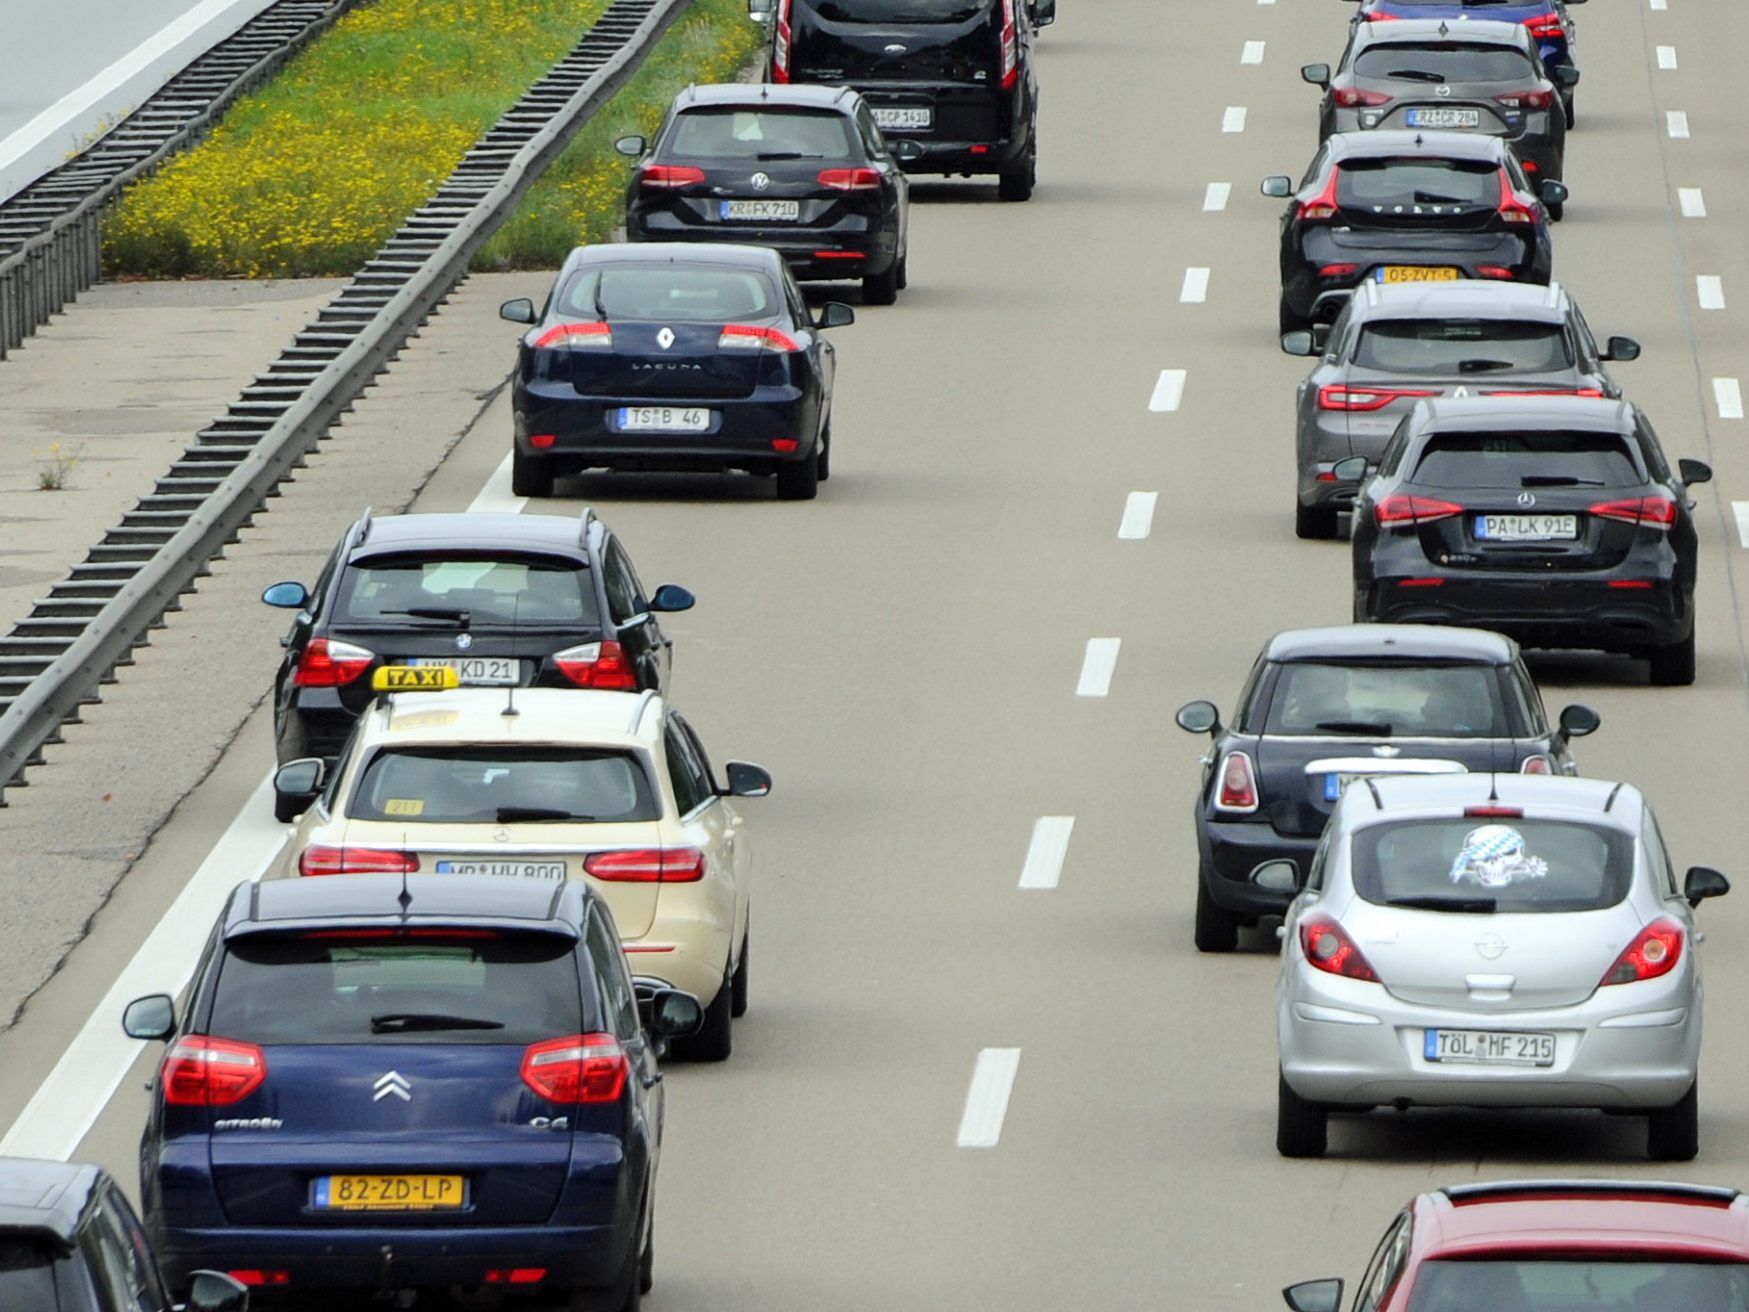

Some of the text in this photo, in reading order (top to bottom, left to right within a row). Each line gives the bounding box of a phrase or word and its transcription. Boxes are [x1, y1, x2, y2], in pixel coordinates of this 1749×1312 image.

[772, 202, 797, 216] 710
[633, 409, 701, 425] TS B 46
[1487, 519, 1506, 532] PA
[1518, 520, 1540, 533] LK
[389, 670, 444, 686] TAXI
[461, 662, 485, 678] KD
[491, 662, 512, 679] 21
[1439, 1033, 1553, 1059] TÖL MF 215
[338, 1178, 452, 1201] 82-ZD-LP
